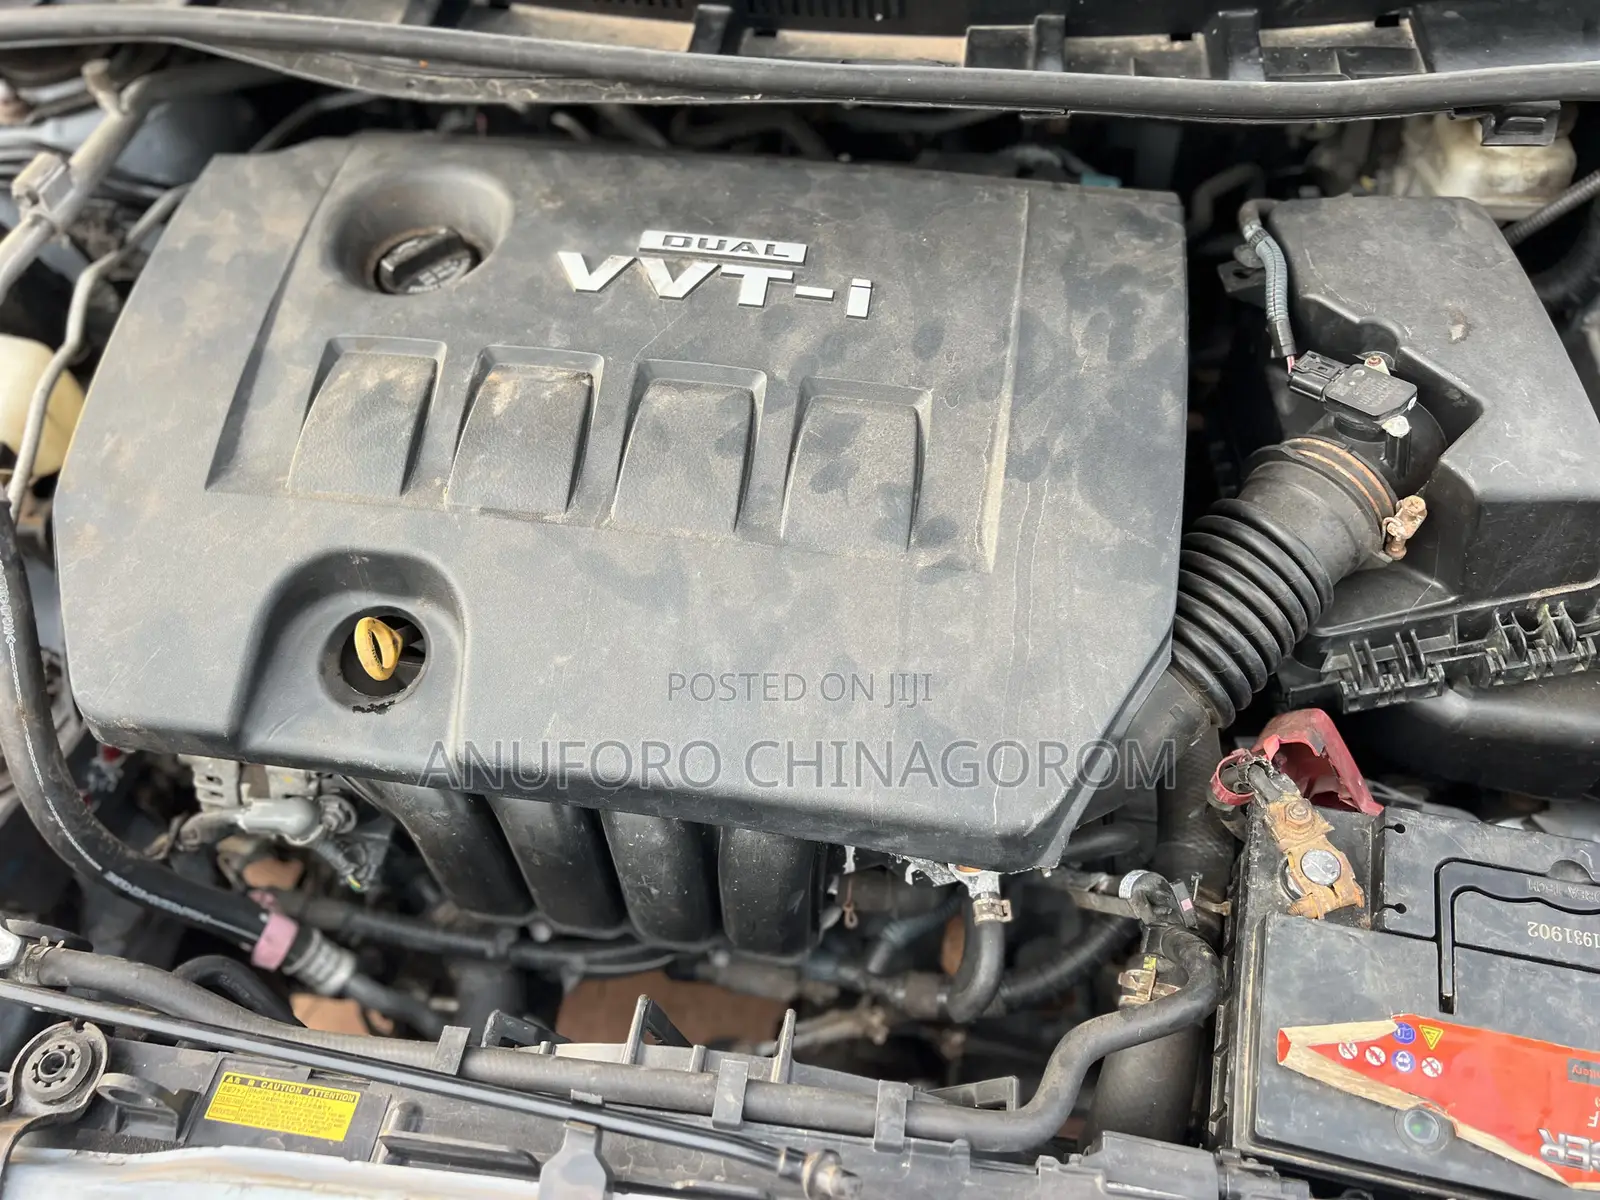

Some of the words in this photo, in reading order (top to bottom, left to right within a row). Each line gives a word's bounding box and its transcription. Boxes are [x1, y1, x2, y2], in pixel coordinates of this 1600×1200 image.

[658, 232, 793, 259] DUAL
[557, 251, 873, 319] VVT-i
[261, 1080, 303, 1094] CAUTION
[308, 1087, 356, 1103] ATTENTION
